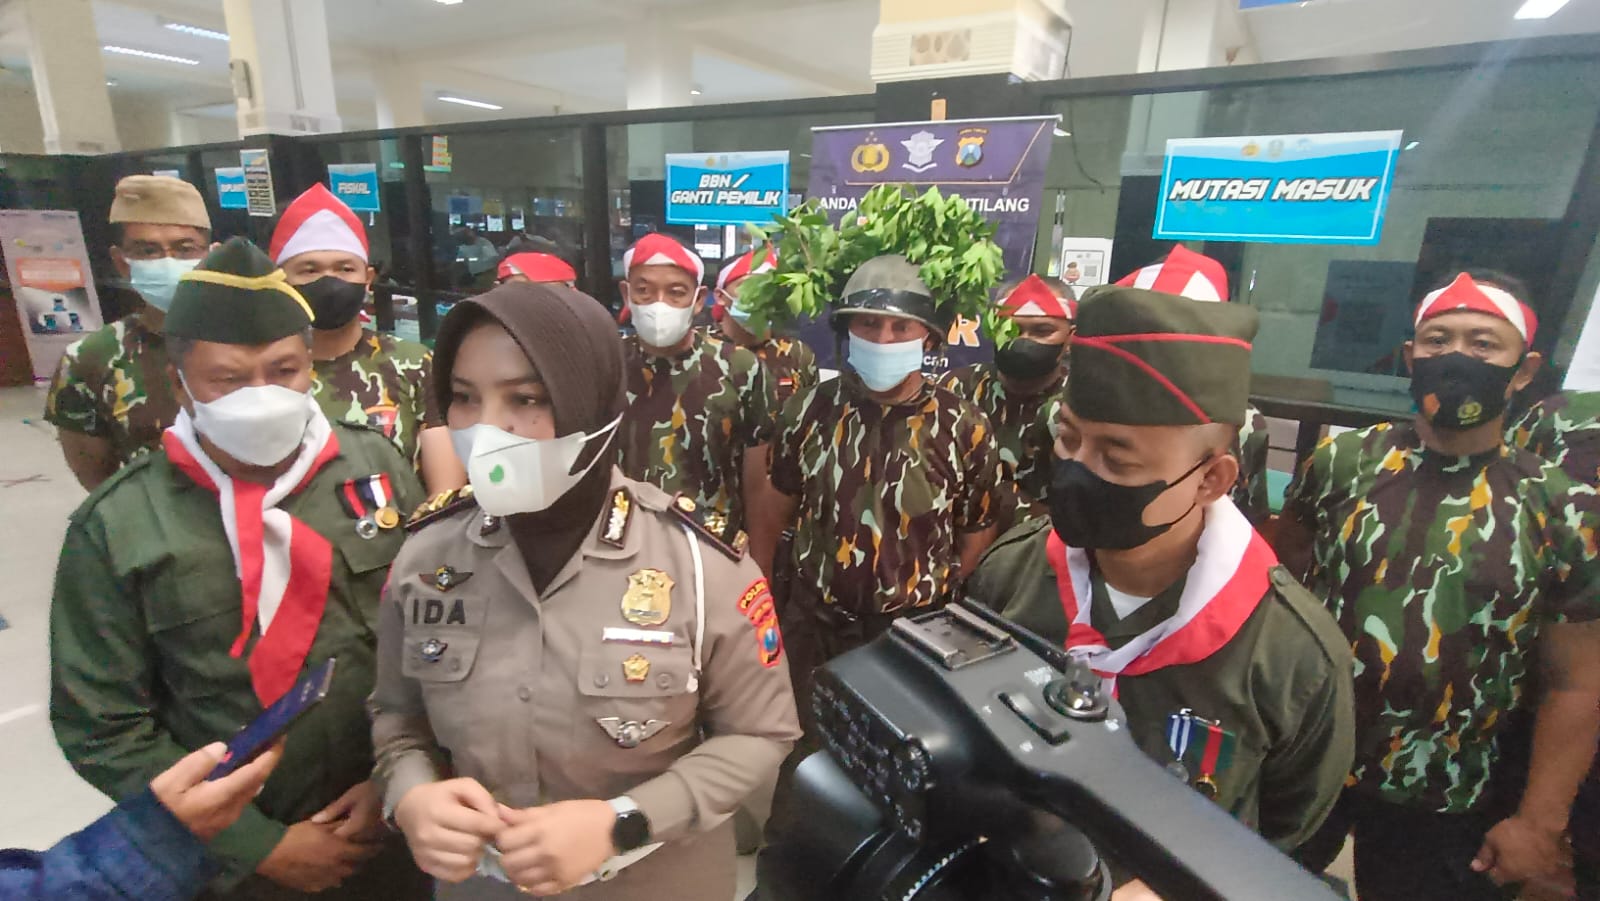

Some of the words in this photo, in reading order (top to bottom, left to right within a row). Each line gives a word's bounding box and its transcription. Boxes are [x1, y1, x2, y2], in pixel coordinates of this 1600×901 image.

[699, 174, 732, 188] BBN
[732, 173, 751, 188] /
[1168, 178, 1271, 201] MUTASI
[1270, 177, 1378, 201] MASUK
[671, 190, 714, 204] GANTI
[716, 190, 781, 206] PEMILIK
[965, 197, 1030, 213] ITILANG
[412, 599, 466, 625] IDA
